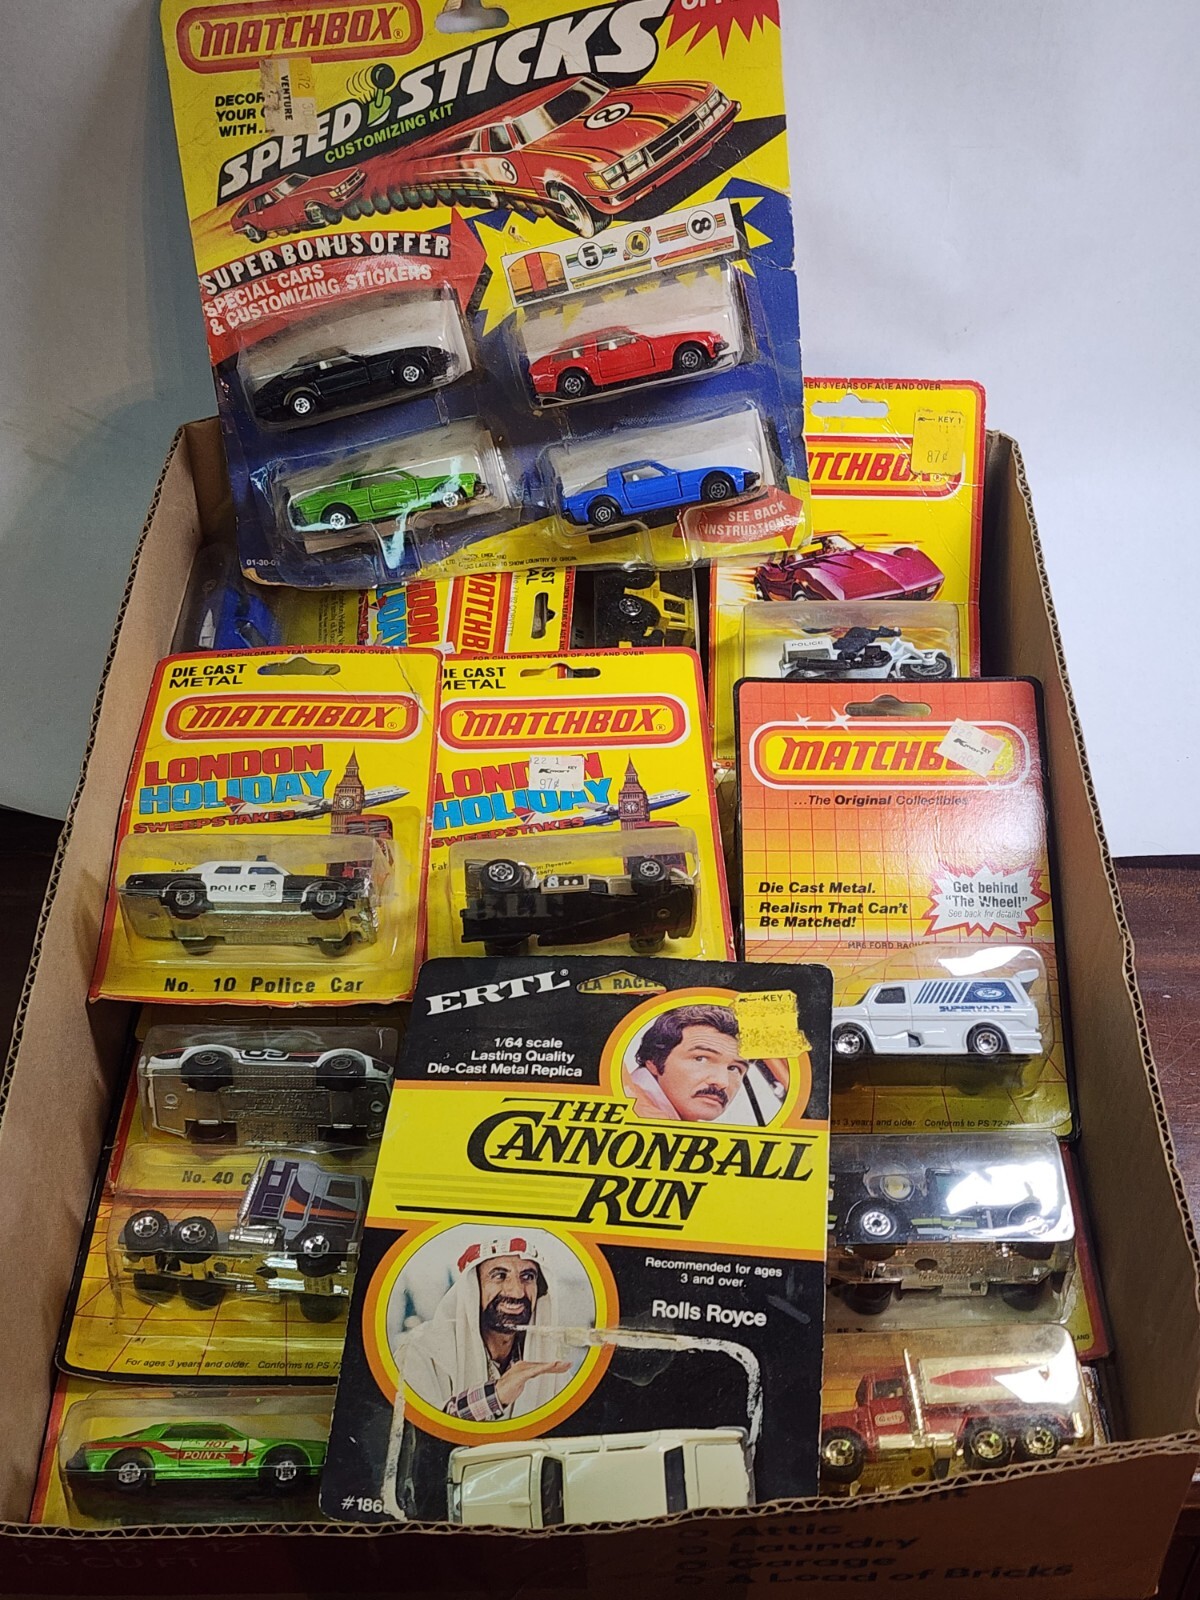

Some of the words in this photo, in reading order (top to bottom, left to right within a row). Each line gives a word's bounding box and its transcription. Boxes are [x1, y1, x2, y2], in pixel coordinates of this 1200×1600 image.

[221, 101, 362, 198] SPEED
[397, 0, 667, 118] STICKS
[280, 74, 293, 121] VENTURE
[216, 110, 256, 122] YOUR
[325, 114, 426, 164] CUSTOMIZING
[430, 103, 454, 121] KIT
[202, 251, 277, 295] SUPER
[281, 234, 363, 266] BONUS
[370, 232, 450, 257] OFFER
[204, 279, 276, 318] SPECIAL
[278, 264, 325, 289] CARS
[209, 317, 225, 336] &
[226, 279, 340, 327] CUSTOMIZING
[346, 264, 432, 291] STICKERS
[830, 382, 858, 390] YEARS
[860, 382, 873, 390] OF
[875, 382, 893, 390] AGE
[895, 383, 915, 391] AND
[728, 511, 750, 523] SEE
[754, 501, 787, 520] BACK
[704, 514, 792, 537] INSTRUCTIONS
[791, 640, 824, 648] POLICE
[172, 664, 197, 677] DIE
[203, 664, 247, 676] CAST
[463, 667, 506, 679] CAST
[169, 675, 243, 689] METAL
[144, 744, 324, 787] LONDON
[139, 770, 332, 815] HOLIDAY
[834, 795, 892, 806] Original
[895, 795, 968, 806] Collectibles
[432, 777, 612, 831] HOLIDAY
[133, 810, 296, 834] SWEEPSTAKES
[431, 816, 585, 849] SWEEPSTAKES
[209, 884, 257, 893] POLICE
[758, 882, 785, 894] Die
[789, 882, 825, 894] Cast
[829, 881, 876, 894] Metal.
[953, 882, 975, 894] Get
[977, 881, 1018, 894] behind
[759, 903, 823, 914] Realism
[827, 903, 862, 914] That
[866, 903, 908, 914] Can't
[948, 909, 963, 918] See
[964, 909, 983, 918] back
[984, 909, 994, 918] for
[759, 916, 780, 927] Be
[783, 916, 857, 927] Matched!
[164, 977, 195, 992] No.
[213, 976, 236, 992] 10
[250, 976, 315, 993] Police
[330, 977, 364, 993] Car
[426, 970, 571, 1016] ERTL
[763, 994, 783, 1002] KEY
[494, 1037, 523, 1049] 1/64
[525, 1037, 563, 1049] scale
[470, 1050, 522, 1064] Lasting
[525, 1049, 575, 1064] Quality
[427, 1062, 488, 1075] Die-Cast
[490, 1063, 529, 1076] Metal
[531, 1065, 583, 1078] Replica
[547, 1099, 629, 1125] THE
[850, 1120, 873, 1128] years
[924, 1119, 965, 1127] Conforms
[977, 1119, 991, 1127] PS
[467, 1110, 822, 1183] CANNONBALL
[182, 1171, 206, 1184] No.
[212, 1171, 234, 1184] 40
[577, 1176, 709, 1231] RUN
[645, 1256, 731, 1273] Recommended
[734, 1262, 751, 1275] for
[754, 1265, 783, 1279] ages
[680, 1273, 689, 1285] 3
[692, 1275, 714, 1286] and
[718, 1277, 748, 1289] over.
[652, 1300, 702, 1321] Rolls
[706, 1304, 768, 1327] Royce
[125, 1358, 142, 1366] For
[143, 1360, 165, 1369] ages
[177, 1360, 201, 1369] years
[204, 1360, 222, 1368] and
[258, 1360, 301, 1369] Conforms
[304, 1361, 314, 1369] to
[316, 1361, 330, 1369] PS
[204, 1440, 228, 1448] HOT
[183, 1451, 226, 1459] POINTS
[734, 1523, 843, 1538] Attic
[729, 1534, 920, 1555] Laundry
[729, 1556, 898, 1572] Garage
[728, 1573, 755, 1584] A
[769, 1570, 878, 1583] Load
[887, 1566, 936, 1581] of
[944, 1562, 1074, 1580] Bricks
